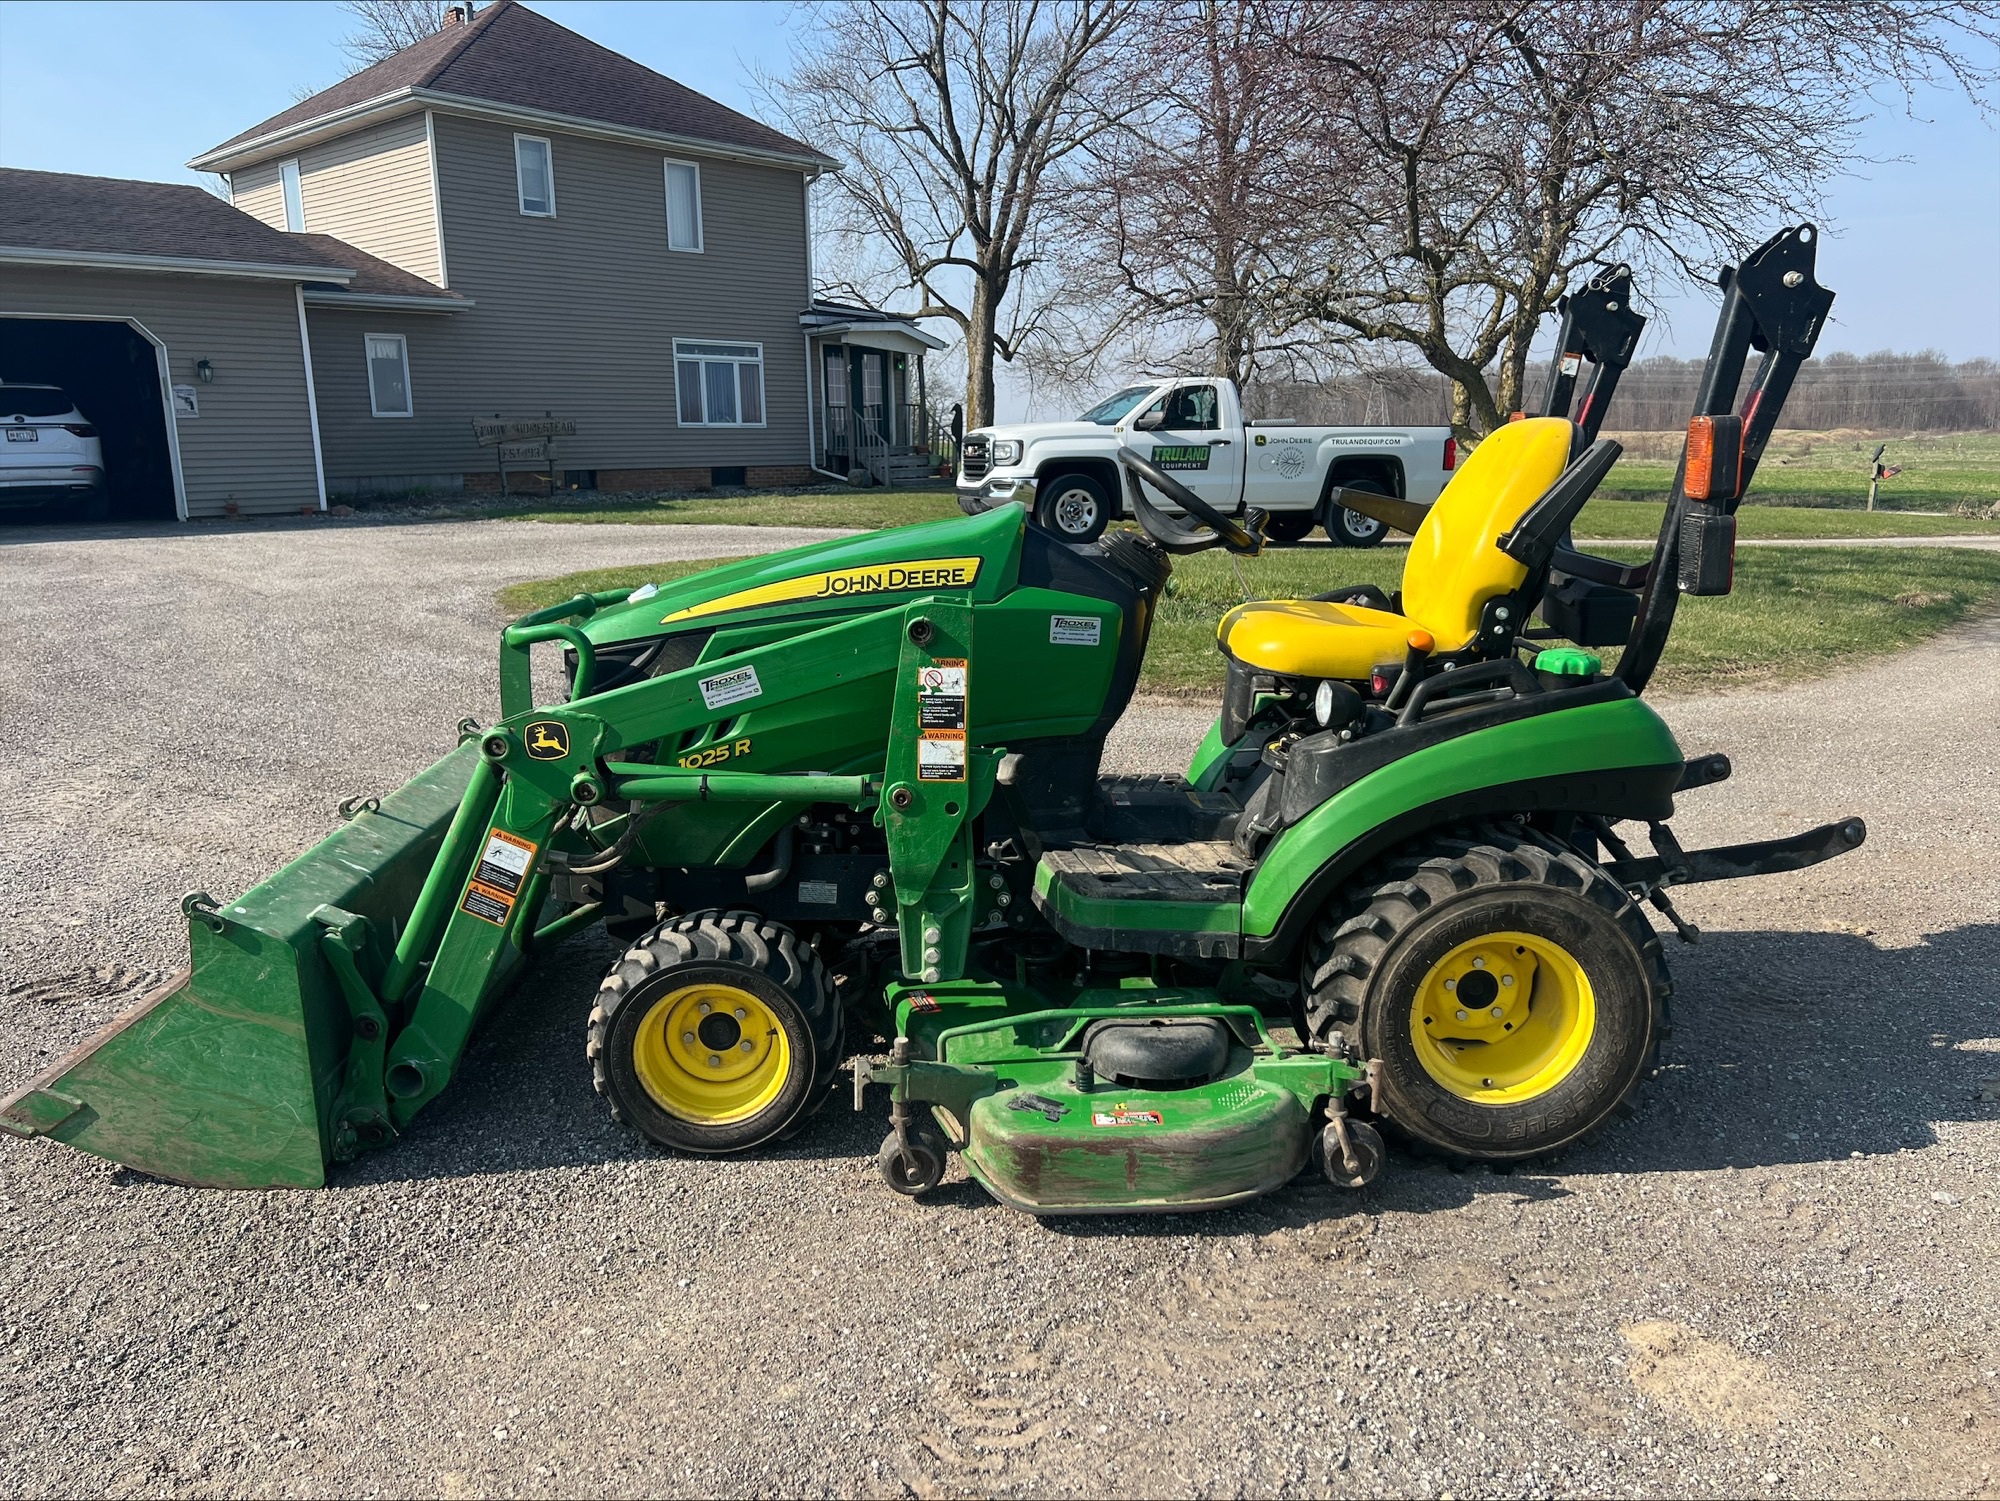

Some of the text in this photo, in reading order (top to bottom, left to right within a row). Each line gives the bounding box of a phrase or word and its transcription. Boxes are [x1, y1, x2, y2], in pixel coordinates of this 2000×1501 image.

[1154, 447, 1208, 461] TRULAND
[817, 568, 966, 597] JOHN DEERE
[1053, 617, 1097, 628] TROXEL
[701, 671, 752, 692] TROXEL
[927, 732, 964, 740] WARNING
[678, 739, 751, 769] 1025 R
[503, 834, 531, 850] WARNING
[481, 887, 509, 903] WARNING
